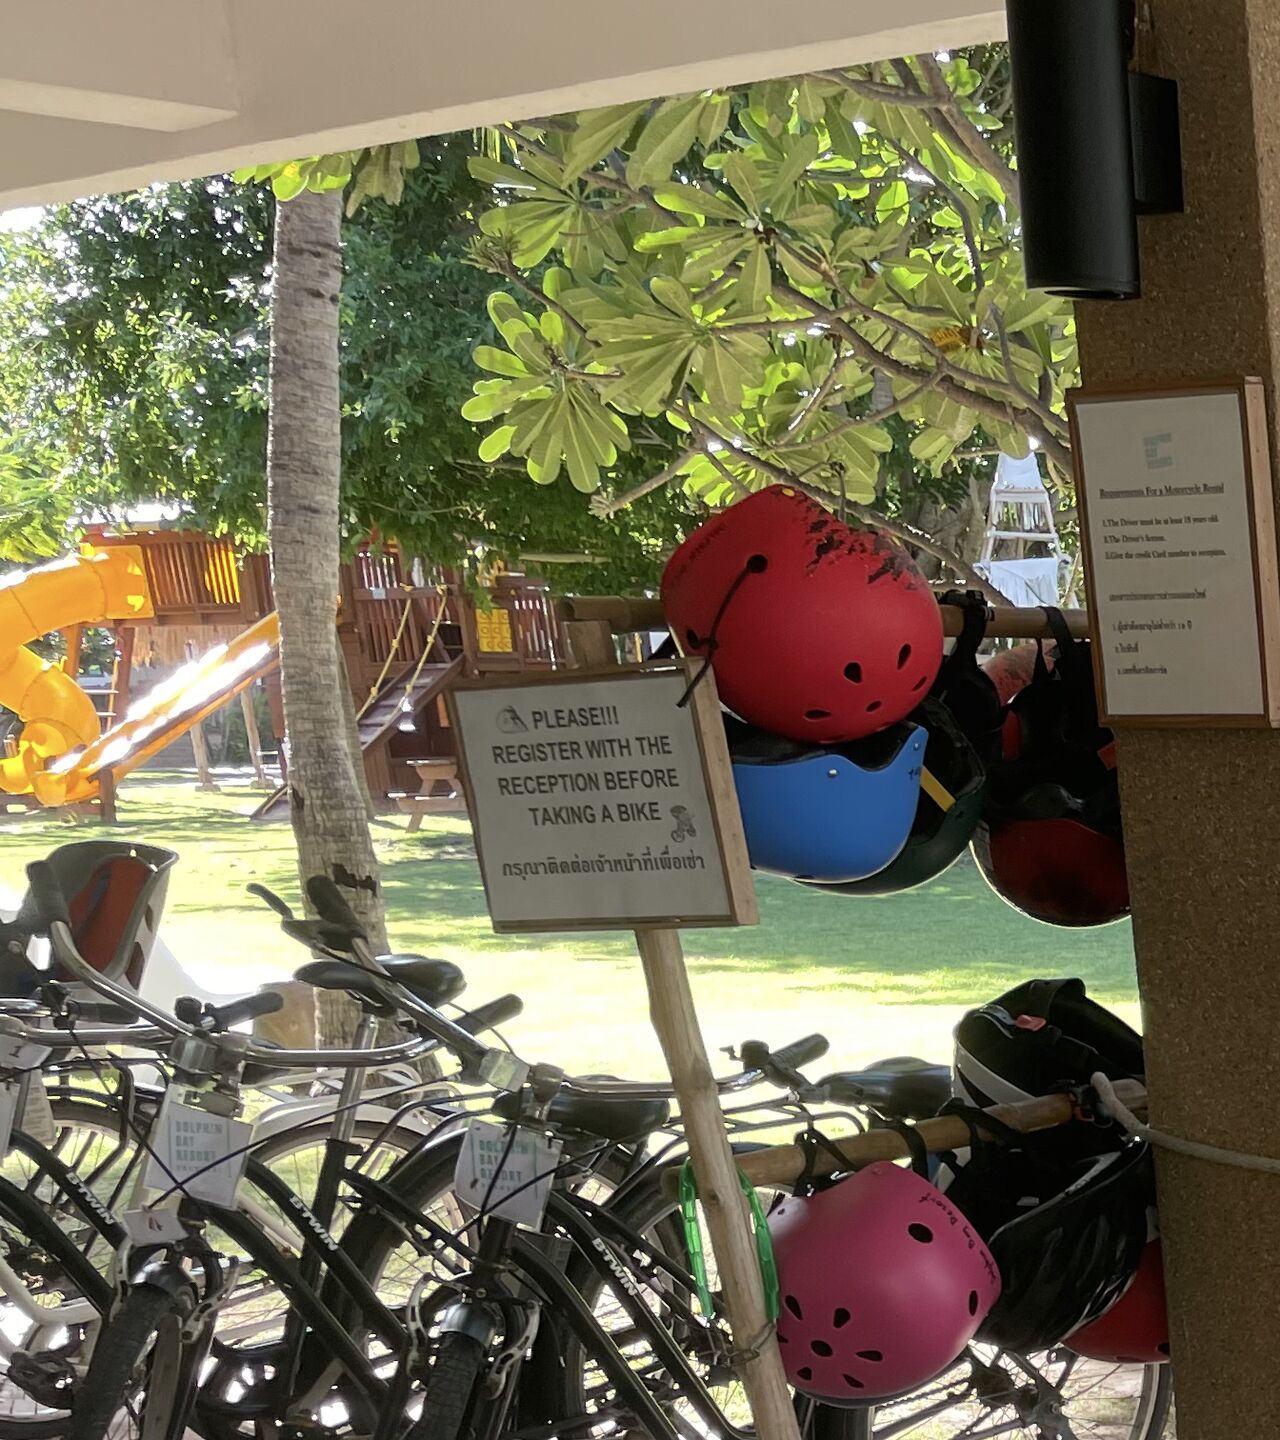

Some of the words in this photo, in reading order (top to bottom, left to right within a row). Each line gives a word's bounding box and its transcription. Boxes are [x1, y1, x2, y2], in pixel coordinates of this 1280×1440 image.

[532, 706, 620, 729] PLEASE!!!
[492, 741, 583, 764] REGISTER
[585, 738, 632, 759] WITH
[635, 736, 672, 756] THE
[497, 773, 600, 796] RECEPTION
[604, 768, 680, 791] BEFORE
[528, 805, 596, 826] TAKING
[601, 804, 614, 823] A
[617, 802, 662, 822] BIKE
[502, 845, 705, 880] กรุณาติดต่อเจ้าหน้าที่เพื่อเช่า
